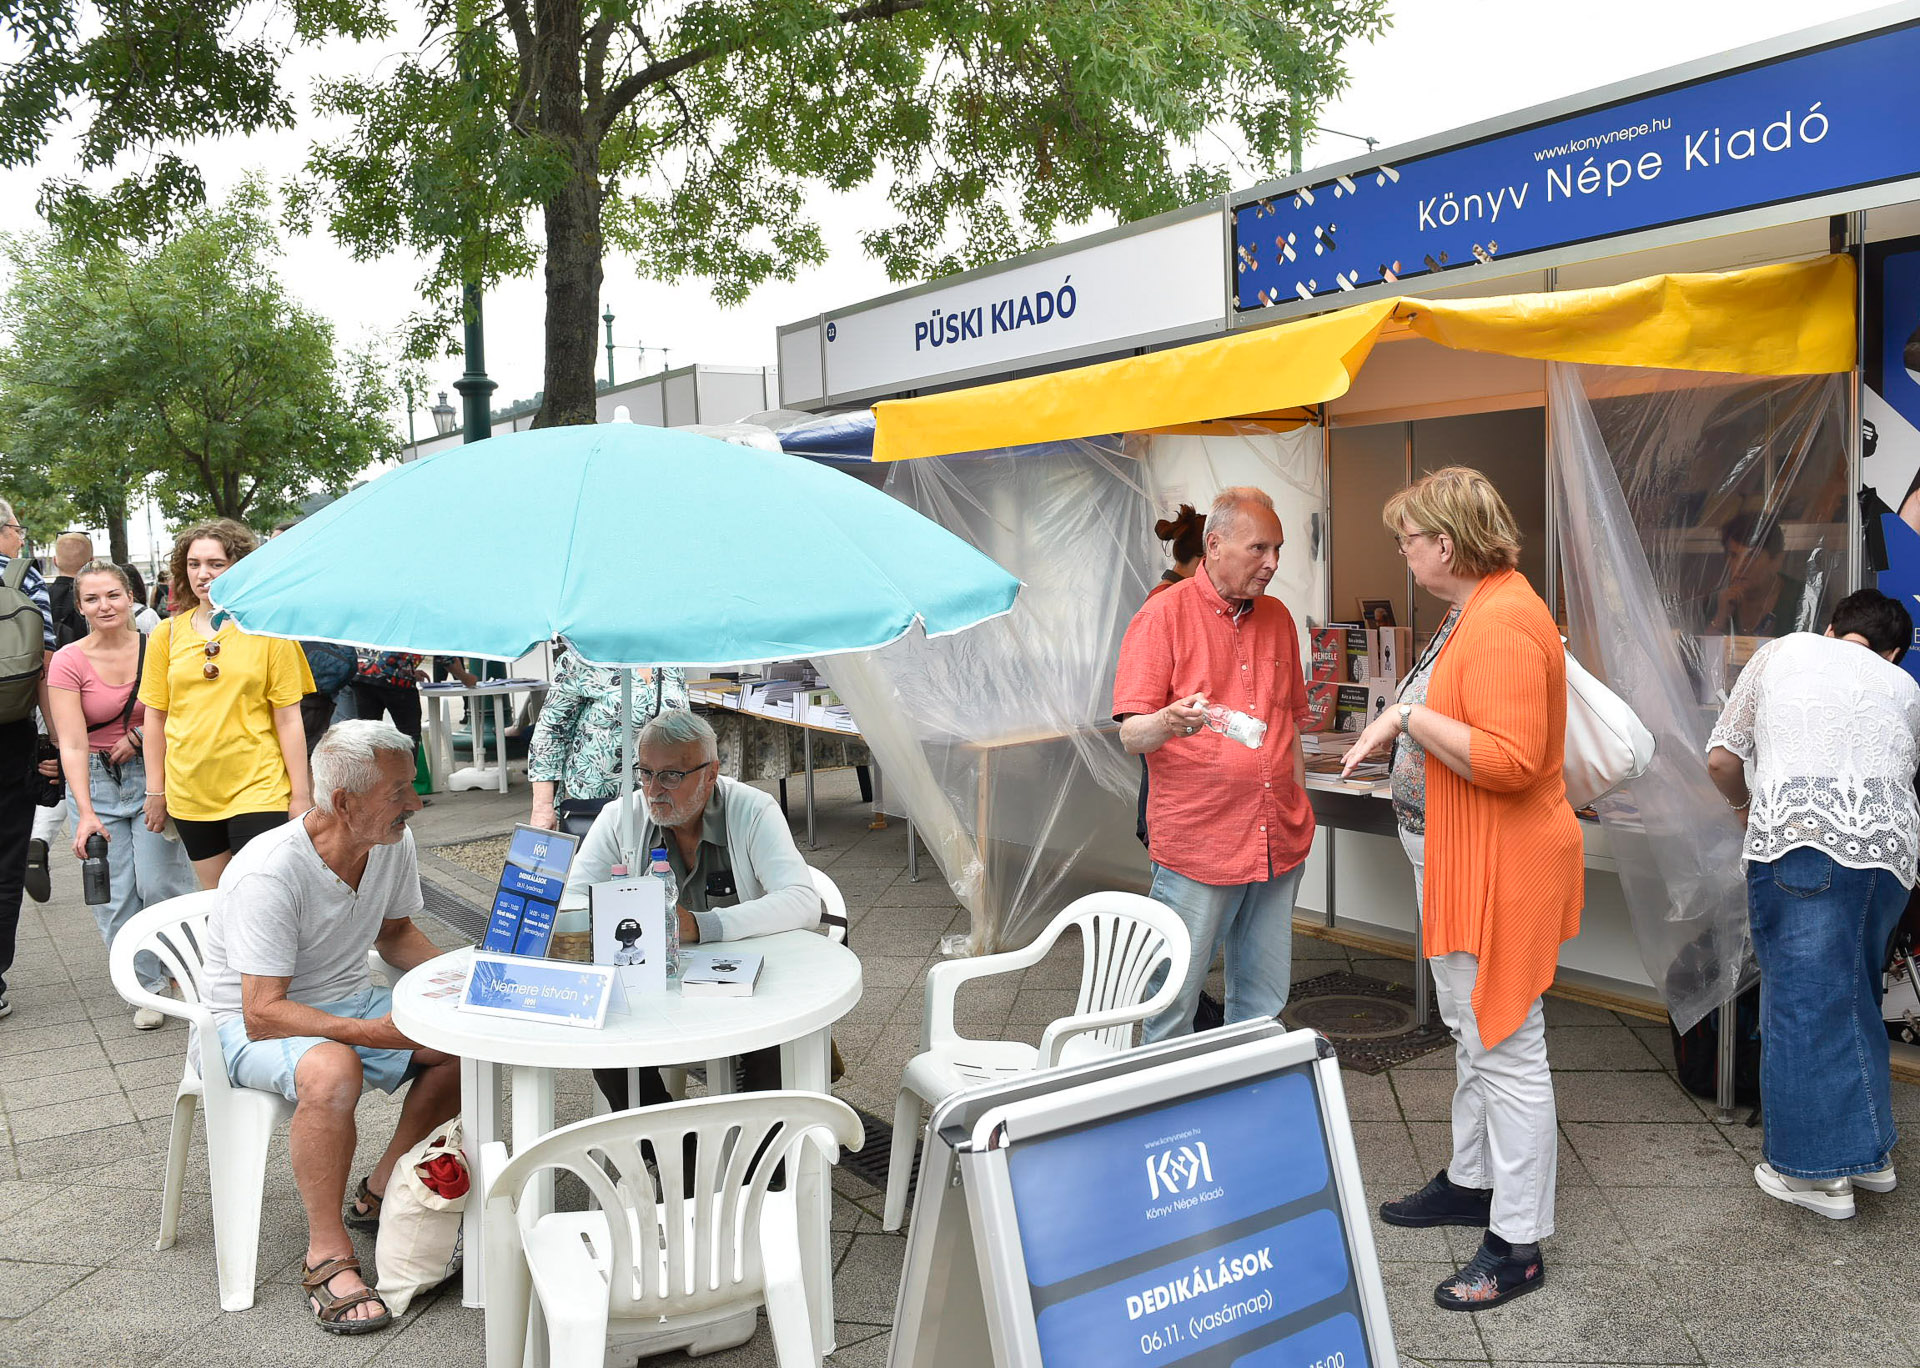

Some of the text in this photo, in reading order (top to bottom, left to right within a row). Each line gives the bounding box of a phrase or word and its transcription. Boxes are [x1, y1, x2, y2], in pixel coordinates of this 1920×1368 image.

[1534, 117, 1672, 161] www.konyvnepe.hu
[1419, 101, 1829, 231] Könyv Népe Kiadó
[915, 275, 1077, 351] PÜSKI KIADÓ
[1312, 651, 1338, 662] MENGELE
[1307, 703, 1329, 713] NGELE
[490, 979, 578, 1001] Nemere István
[1145, 1186, 1225, 1220] Könyv Népe Kiadó
[1126, 1247, 1274, 1320] DEDIKÁLÁSOK
[1140, 1288, 1273, 1355] 06.11. (vasárnap)
